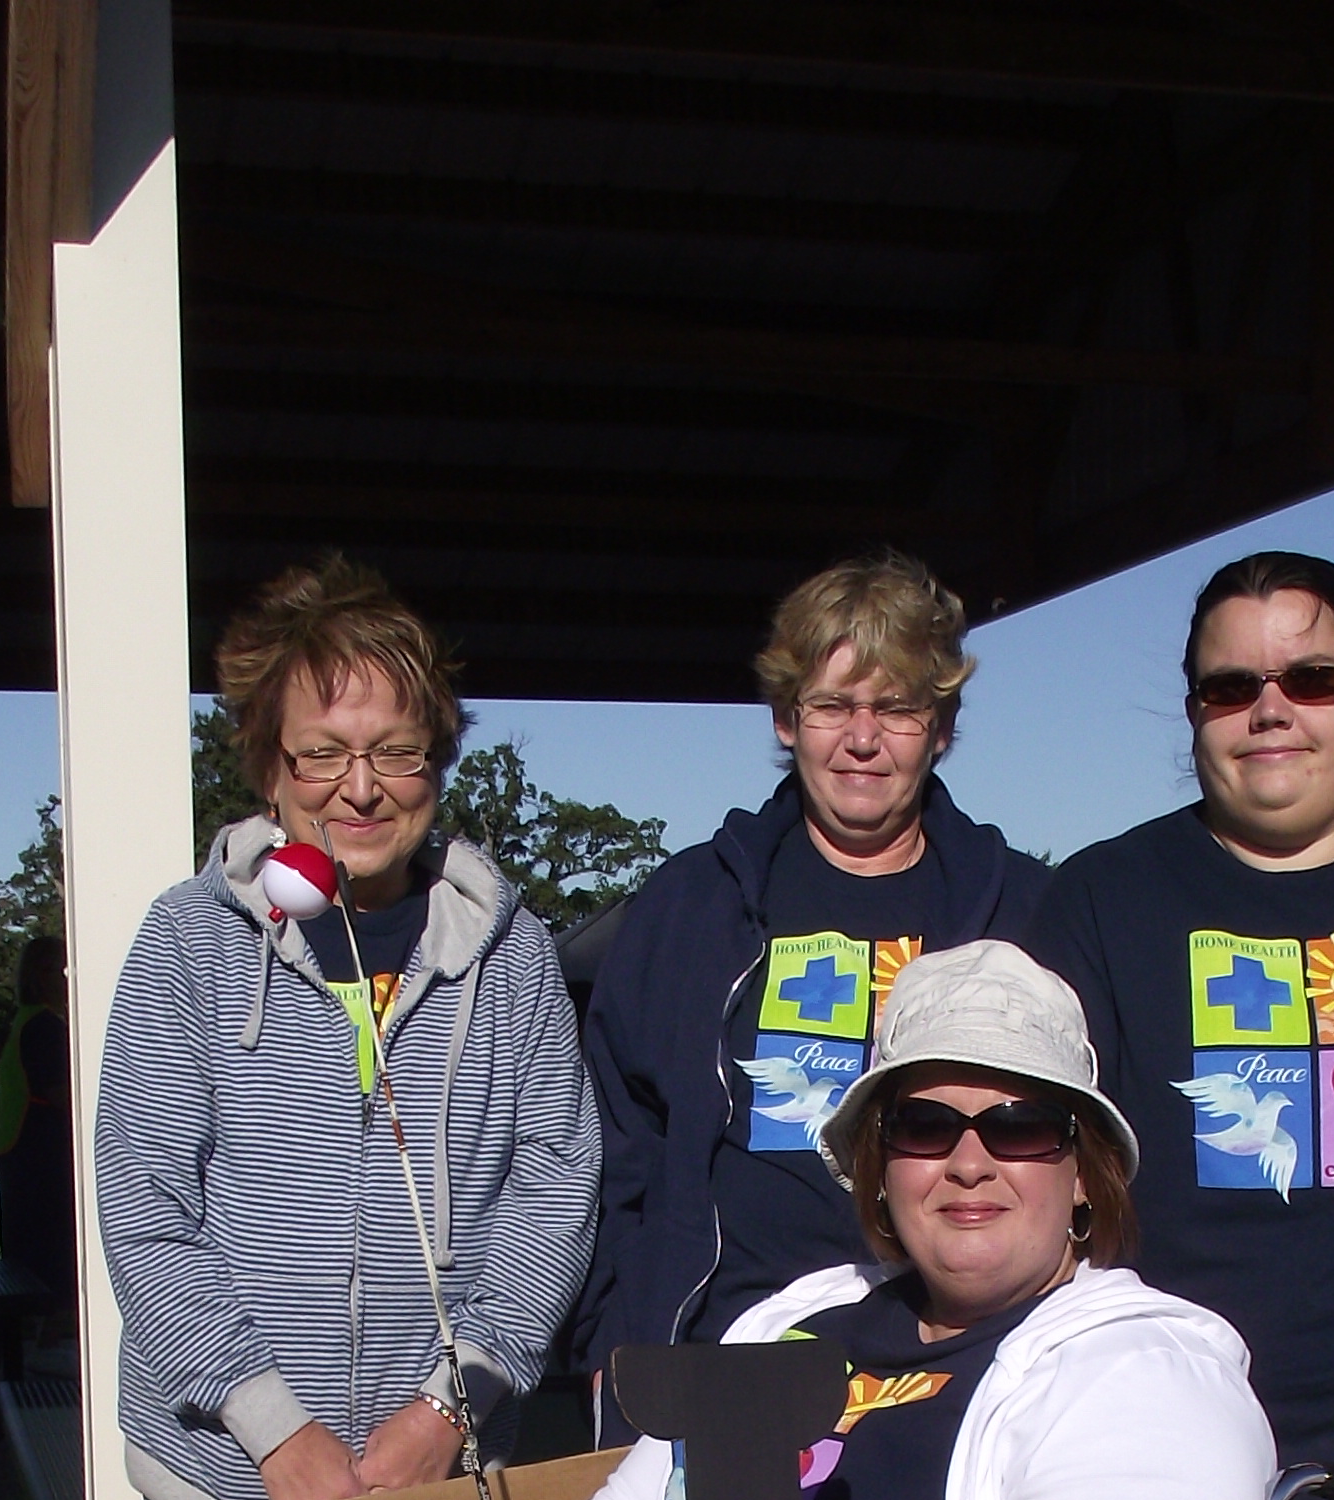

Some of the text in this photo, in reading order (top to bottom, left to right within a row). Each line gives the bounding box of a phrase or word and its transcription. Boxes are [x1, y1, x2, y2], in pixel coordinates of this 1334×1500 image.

[775, 942, 814, 955] HOME
[1194, 937, 1297, 958] HOME HEALTH
[794, 1042, 858, 1072] Peace
[1236, 1052, 1308, 1084] Peace
